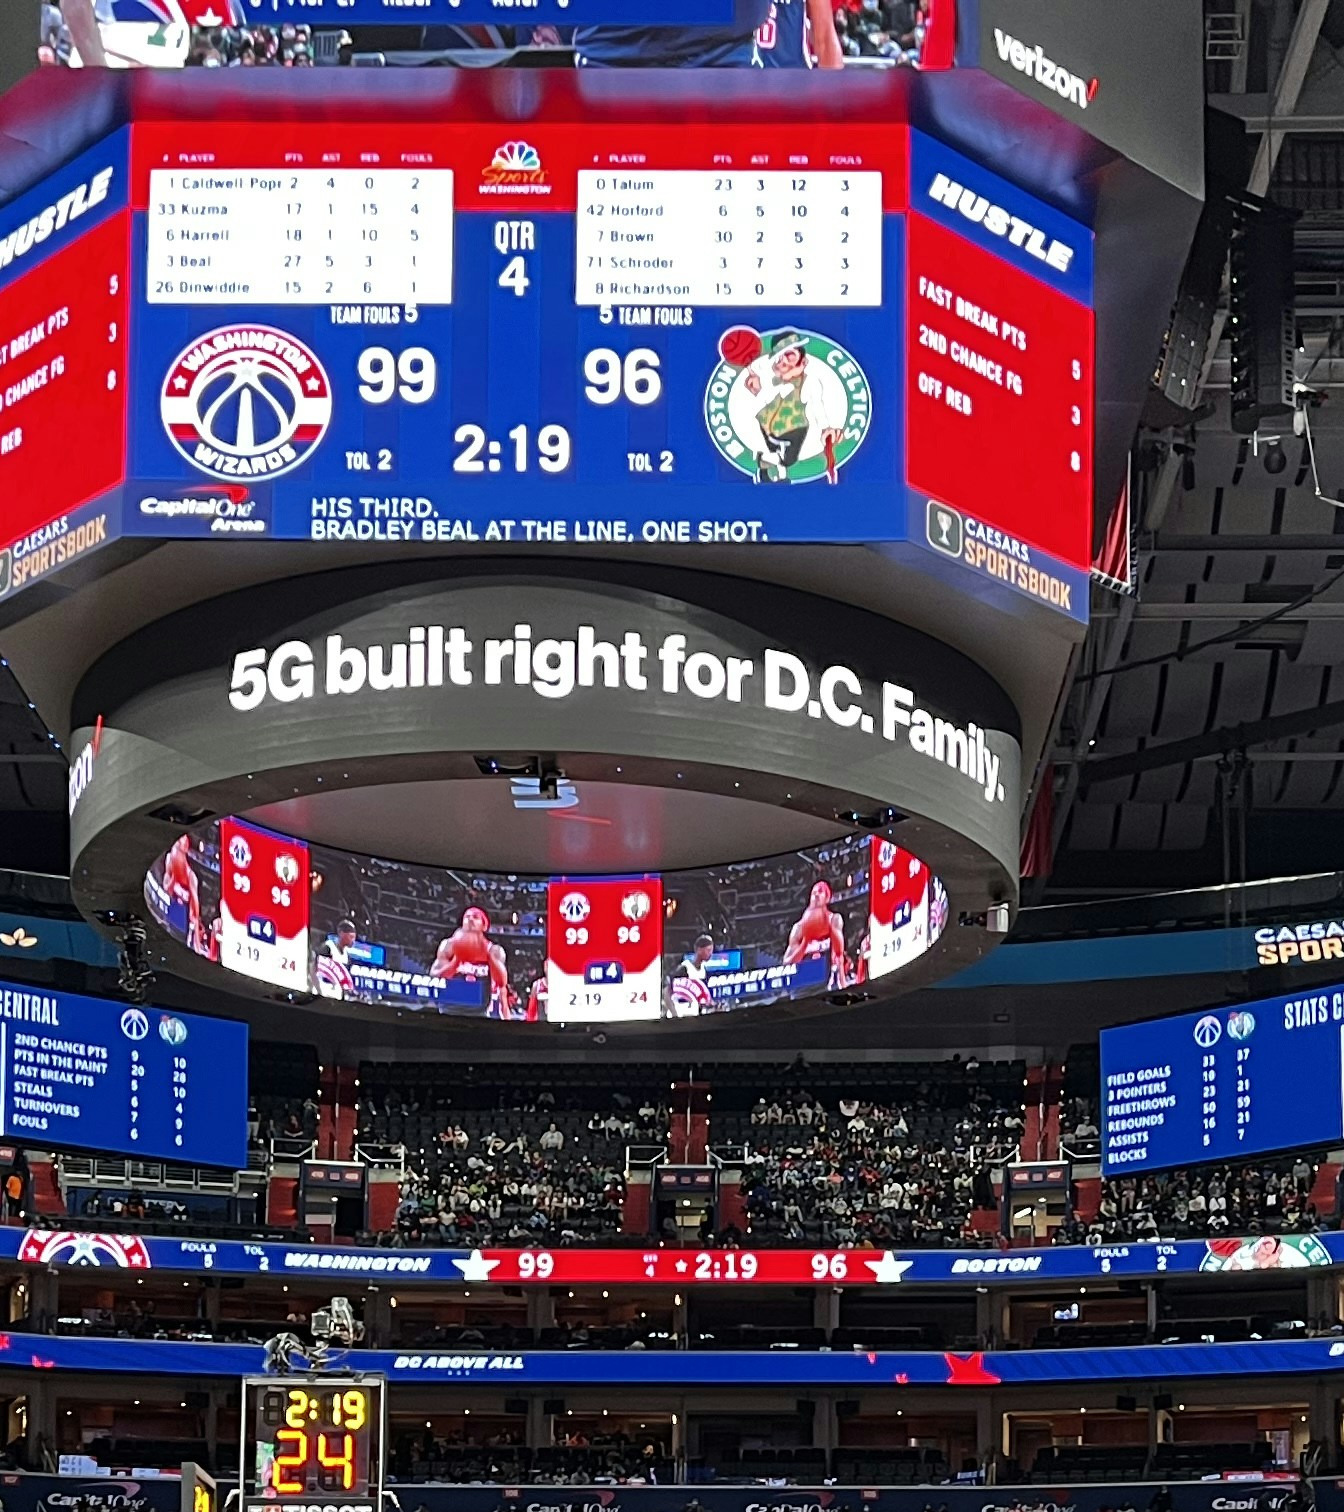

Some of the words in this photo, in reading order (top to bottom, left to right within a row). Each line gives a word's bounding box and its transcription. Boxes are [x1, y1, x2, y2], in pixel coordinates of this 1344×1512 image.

[993, 28, 1089, 109] verizon
[182, 177, 243, 189] Caldwell
[611, 179, 654, 190] Tatum
[158, 204, 175, 215] 33
[181, 204, 228, 215] Kuzma
[286, 203, 302, 215] 17
[611, 205, 663, 217] Horford
[928, 172, 1075, 273] HUSTLE
[181, 230, 229, 241] Harrell
[286, 230, 302, 241] 18
[494, 220, 535, 253] QTR
[610, 231, 654, 243] Brown
[180, 256, 211, 267] Beal
[284, 256, 302, 267] 27
[610, 257, 674, 269] Schroder
[156, 282, 174, 294] 26
[179, 282, 250, 294] Dinwiddie
[285, 282, 302, 294] 15
[498, 256, 530, 297] 4
[610, 283, 690, 295] Richardson
[331, 306, 362, 324] TEAM
[364, 306, 400, 324] FOULS
[405, 302, 418, 324] 5
[599, 303, 613, 324] 5
[619, 307, 652, 325] TEAM
[655, 307, 693, 326] FOULS
[919, 276, 951, 312] FAST
[956, 296, 998, 337] BREAK
[1001, 320, 1027, 351] PTS
[10, 321, 46, 361] BREAK
[47, 307, 69, 338] PTS
[181, 331, 311, 374] WASHINGTON
[919, 324, 947, 356] 2ND
[950, 341, 1003, 387] CHANCE
[1006, 370, 1023, 395] FG
[5, 366, 48, 407] CHANCE
[50, 356, 65, 380] FG
[357, 346, 437, 404] 99
[583, 348, 661, 405] 96
[826, 349, 870, 441] CELTICS
[918, 371, 943, 400] OFF
[946, 386, 972, 417] REB
[708, 365, 745, 460] BOSTON
[0, 427, 23, 457] REB
[452, 423, 572, 473] 2:19
[194, 443, 297, 475] WIZARDS
[346, 451, 370, 470] TOL
[377, 448, 392, 471] 2
[627, 452, 653, 472] TOL
[659, 450, 674, 472] 2
[311, 497, 352, 518] HIS
[358, 497, 439, 518] THIRD.
[13, 515, 68, 558] CAESARS
[211, 518, 265, 532] Arena
[311, 519, 415, 541] BRADLEY
[421, 519, 479, 541] BEAL
[484, 519, 516, 541] AT
[522, 519, 566, 542] THE
[574, 519, 634, 544] LINE,
[641, 520, 692, 542] ONE
[697, 520, 768, 543] SHOT.
[12, 514, 107, 588] SPORTSBOOK
[965, 518, 1029, 562] CAESARS
[965, 539, 1072, 611] SPORTSBOOK
[228, 640, 315, 711] 5G
[325, 625, 473, 695] built
[484, 623, 648, 699] right
[658, 634, 754, 702] for
[764, 648, 874, 734] D.C.
[882, 680, 1005, 803] Family.
[564, 927, 589, 946] 99
[616, 926, 641, 945] 96
[1284, 998, 1328, 1030] STATS
[284, 1252, 431, 1272] WASHINGTON
[517, 1252, 555, 1280] 99
[694, 1252, 758, 1281] 2:19
[811, 1252, 848, 1280] 96
[951, 1257, 1043, 1275] BOSTON
[394, 1356, 423, 1368] DC
[423, 1356, 489, 1369] ABOVE
[488, 1357, 524, 1369] ALL
[285, 1390, 365, 1429] 2:19
[271, 1429, 353, 1493] 24
